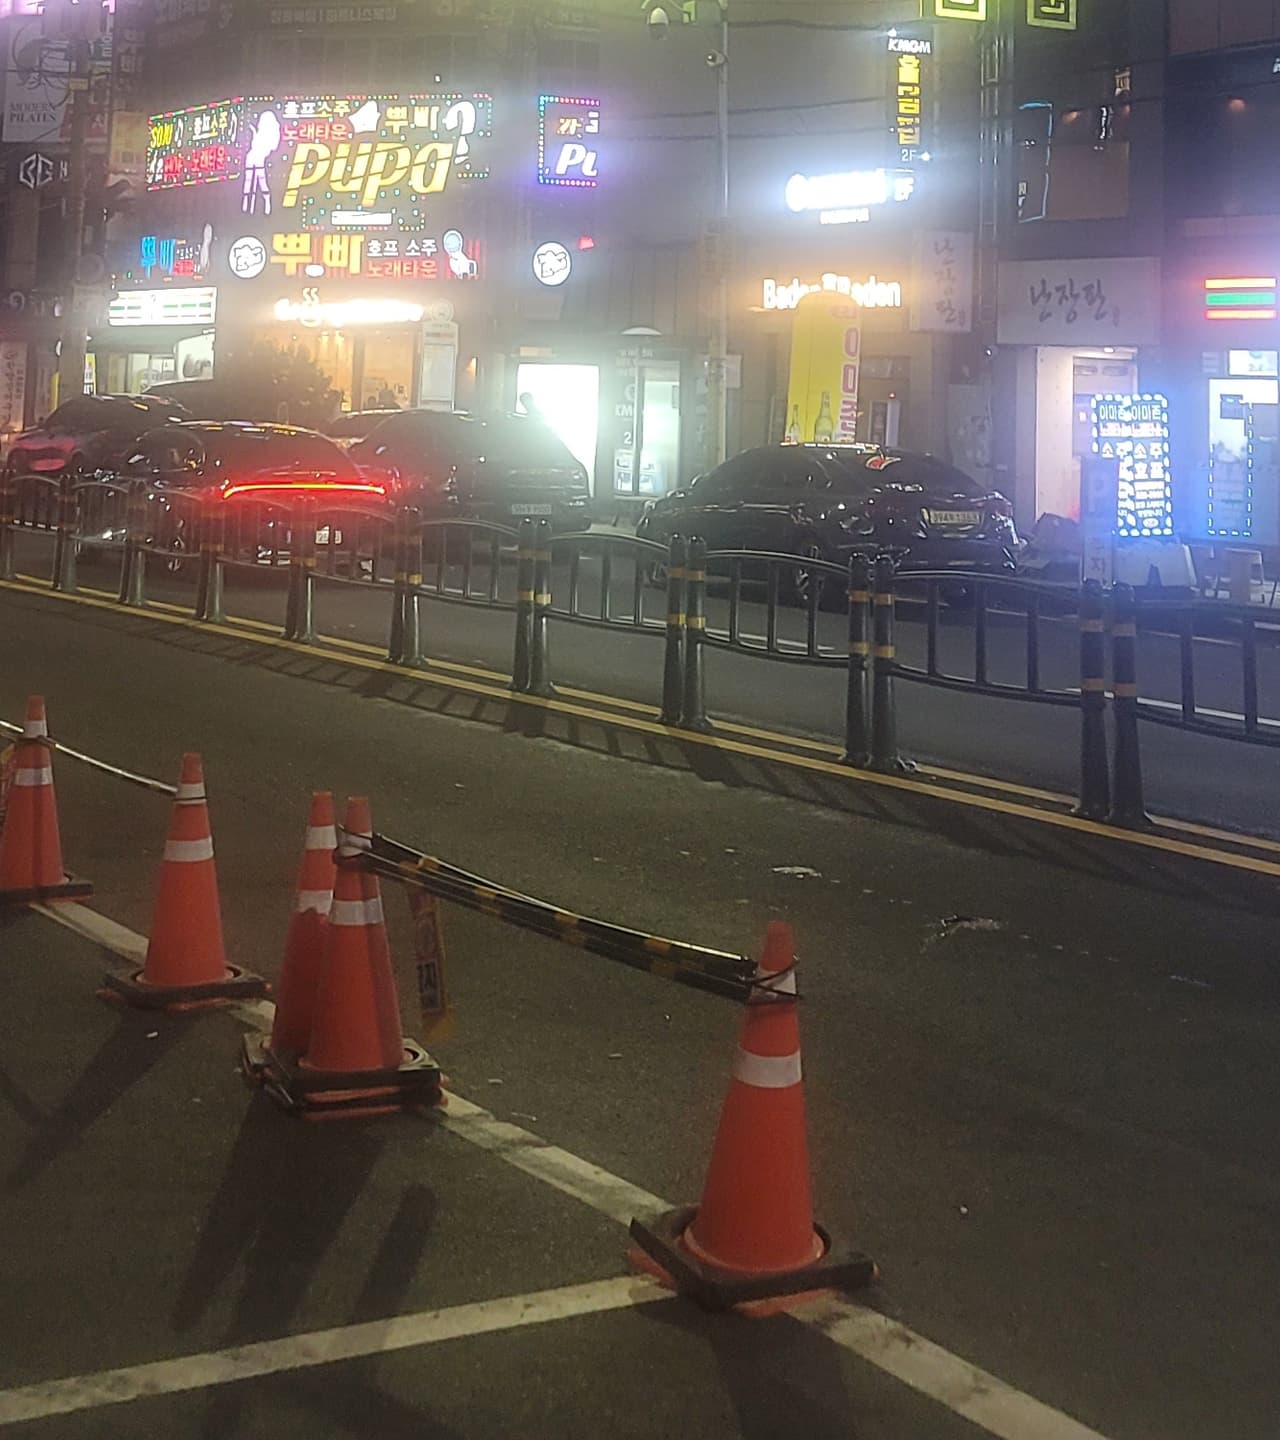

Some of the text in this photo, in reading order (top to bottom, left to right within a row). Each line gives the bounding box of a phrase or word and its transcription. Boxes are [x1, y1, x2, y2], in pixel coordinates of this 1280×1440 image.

[887, 38, 932, 55] KMGM
[367, 238, 400, 258] 호프
[405, 238, 438, 258] 소주
[367, 259, 438, 280] 노래타운
